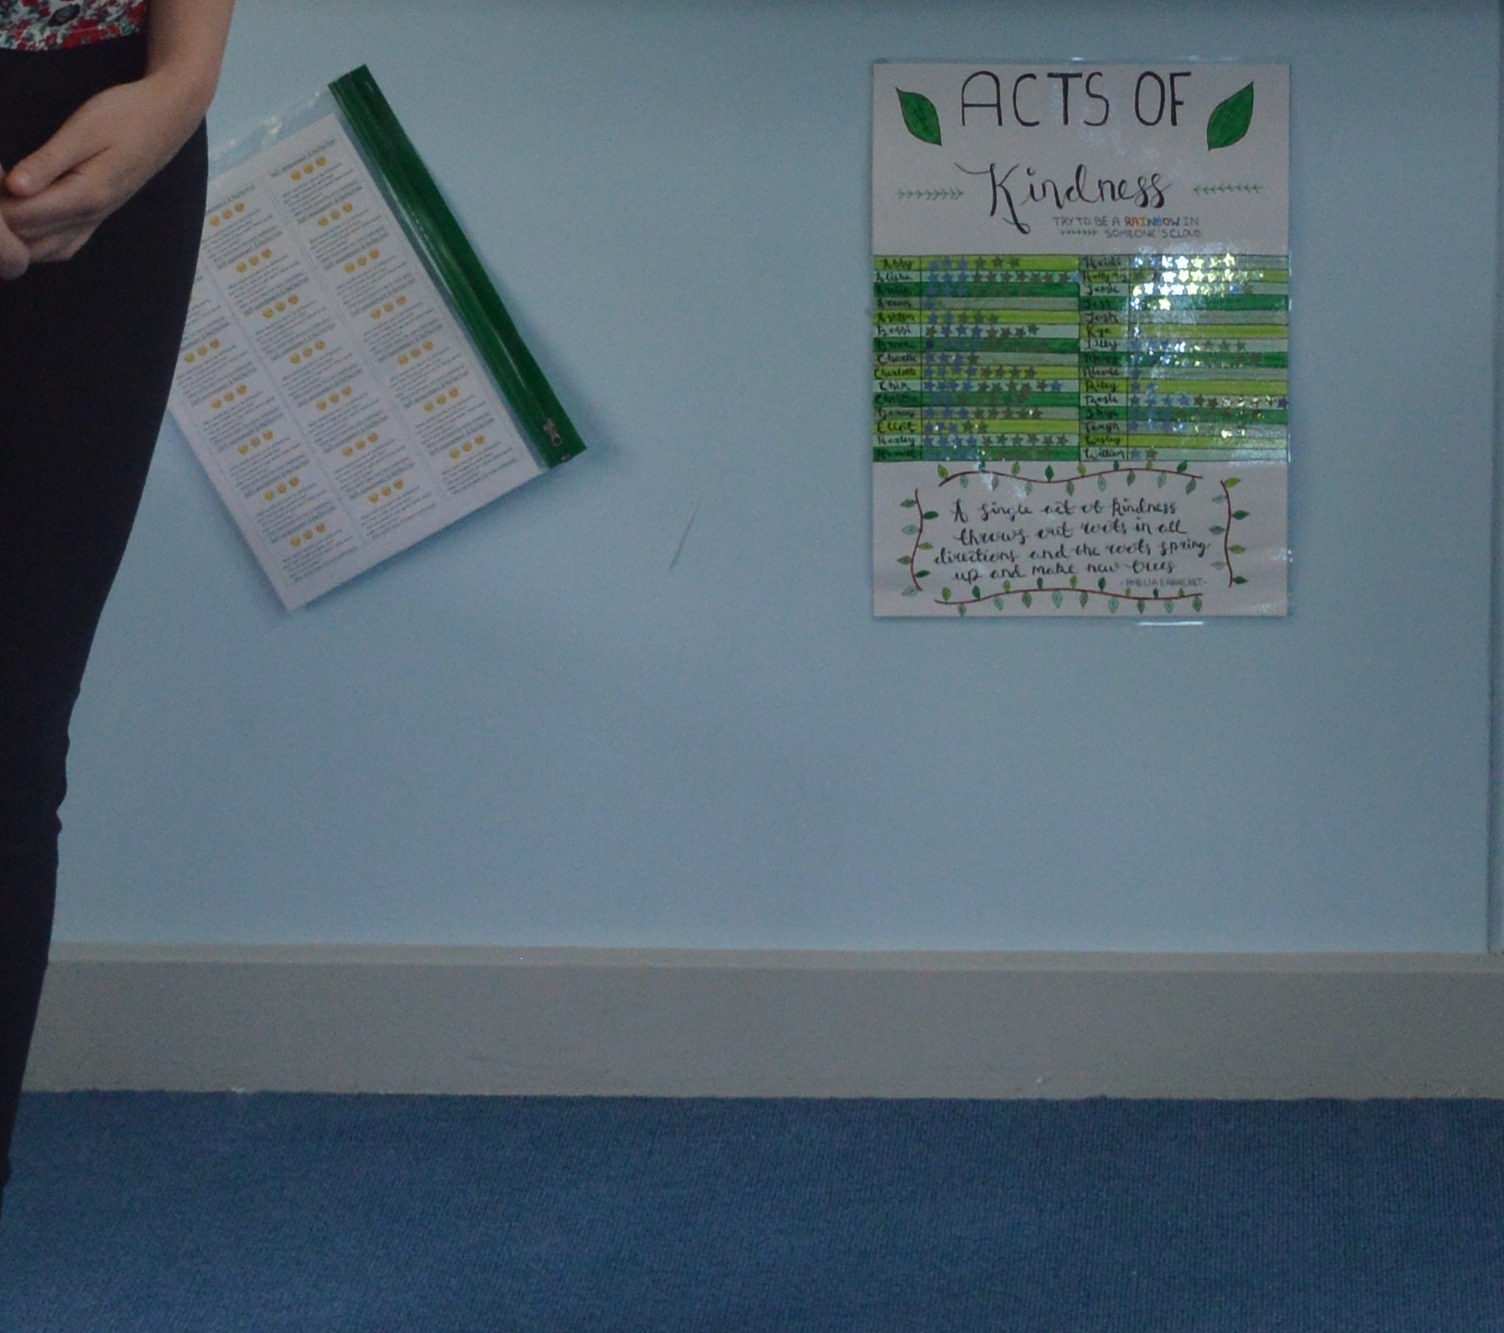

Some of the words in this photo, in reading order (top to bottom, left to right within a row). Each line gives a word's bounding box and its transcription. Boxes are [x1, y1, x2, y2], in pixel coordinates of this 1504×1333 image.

[960, 71, 1111, 127] ACTS
[1133, 70, 1192, 127] OF
[954, 160, 1172, 235] Kindness
